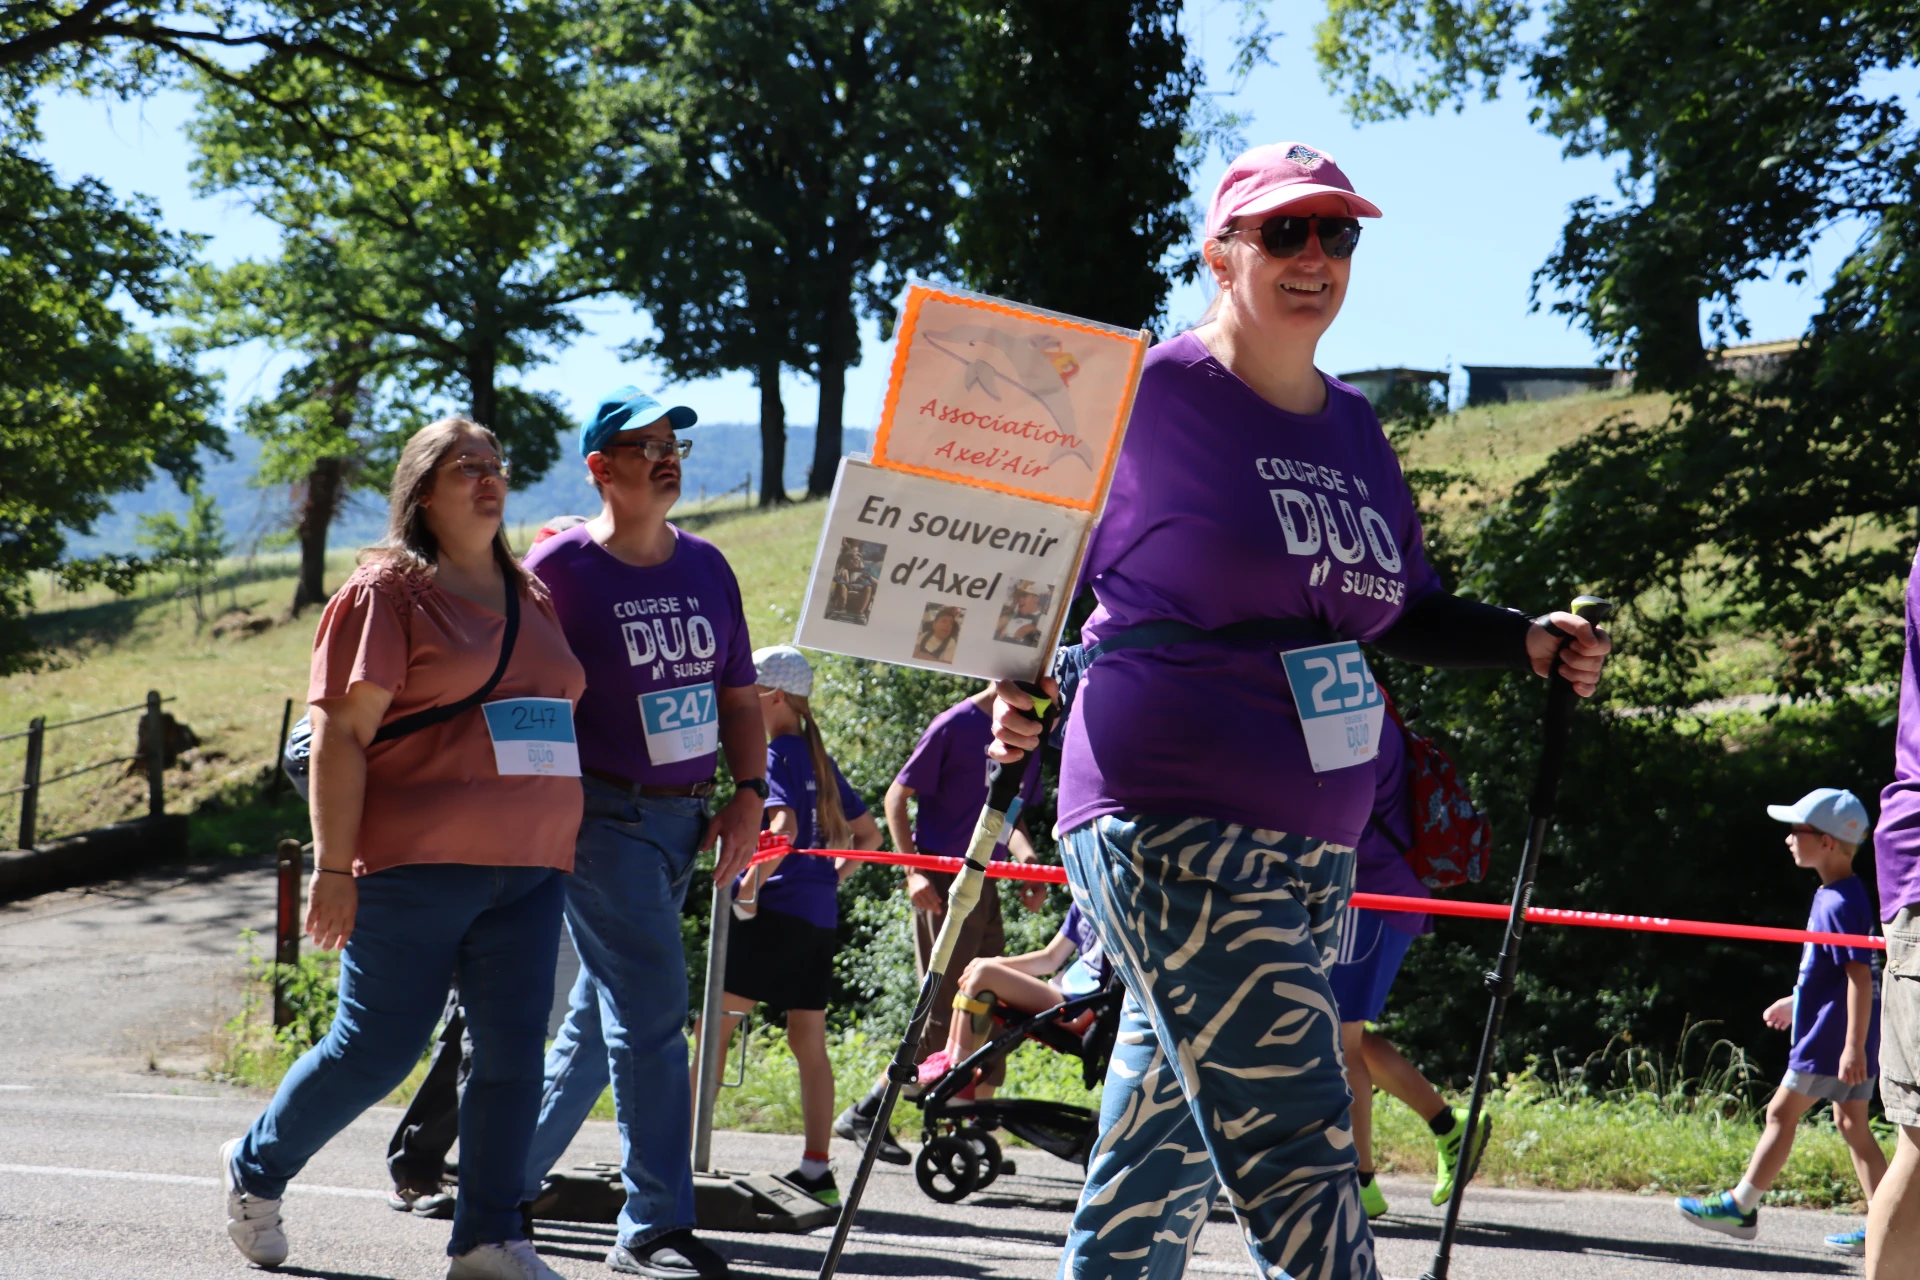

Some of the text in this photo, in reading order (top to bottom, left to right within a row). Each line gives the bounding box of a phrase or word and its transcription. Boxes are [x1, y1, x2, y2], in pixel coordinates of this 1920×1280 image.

[919, 398, 1083, 449] Association
[1256, 457, 1348, 494] COURSE
[857, 495, 1058, 558] En souvenir
[1269, 489, 1402, 574] DUO
[1341, 570, 1405, 606] SUISSE
[613, 596, 681, 618] COURSE
[621, 615, 716, 667] DUO
[672, 660, 716, 678] SUISSE
[511, 706, 557, 730] 247
[655, 689, 714, 730] 247
[1346, 723, 1369, 748] DUO
[528, 749, 554, 762] DUO
